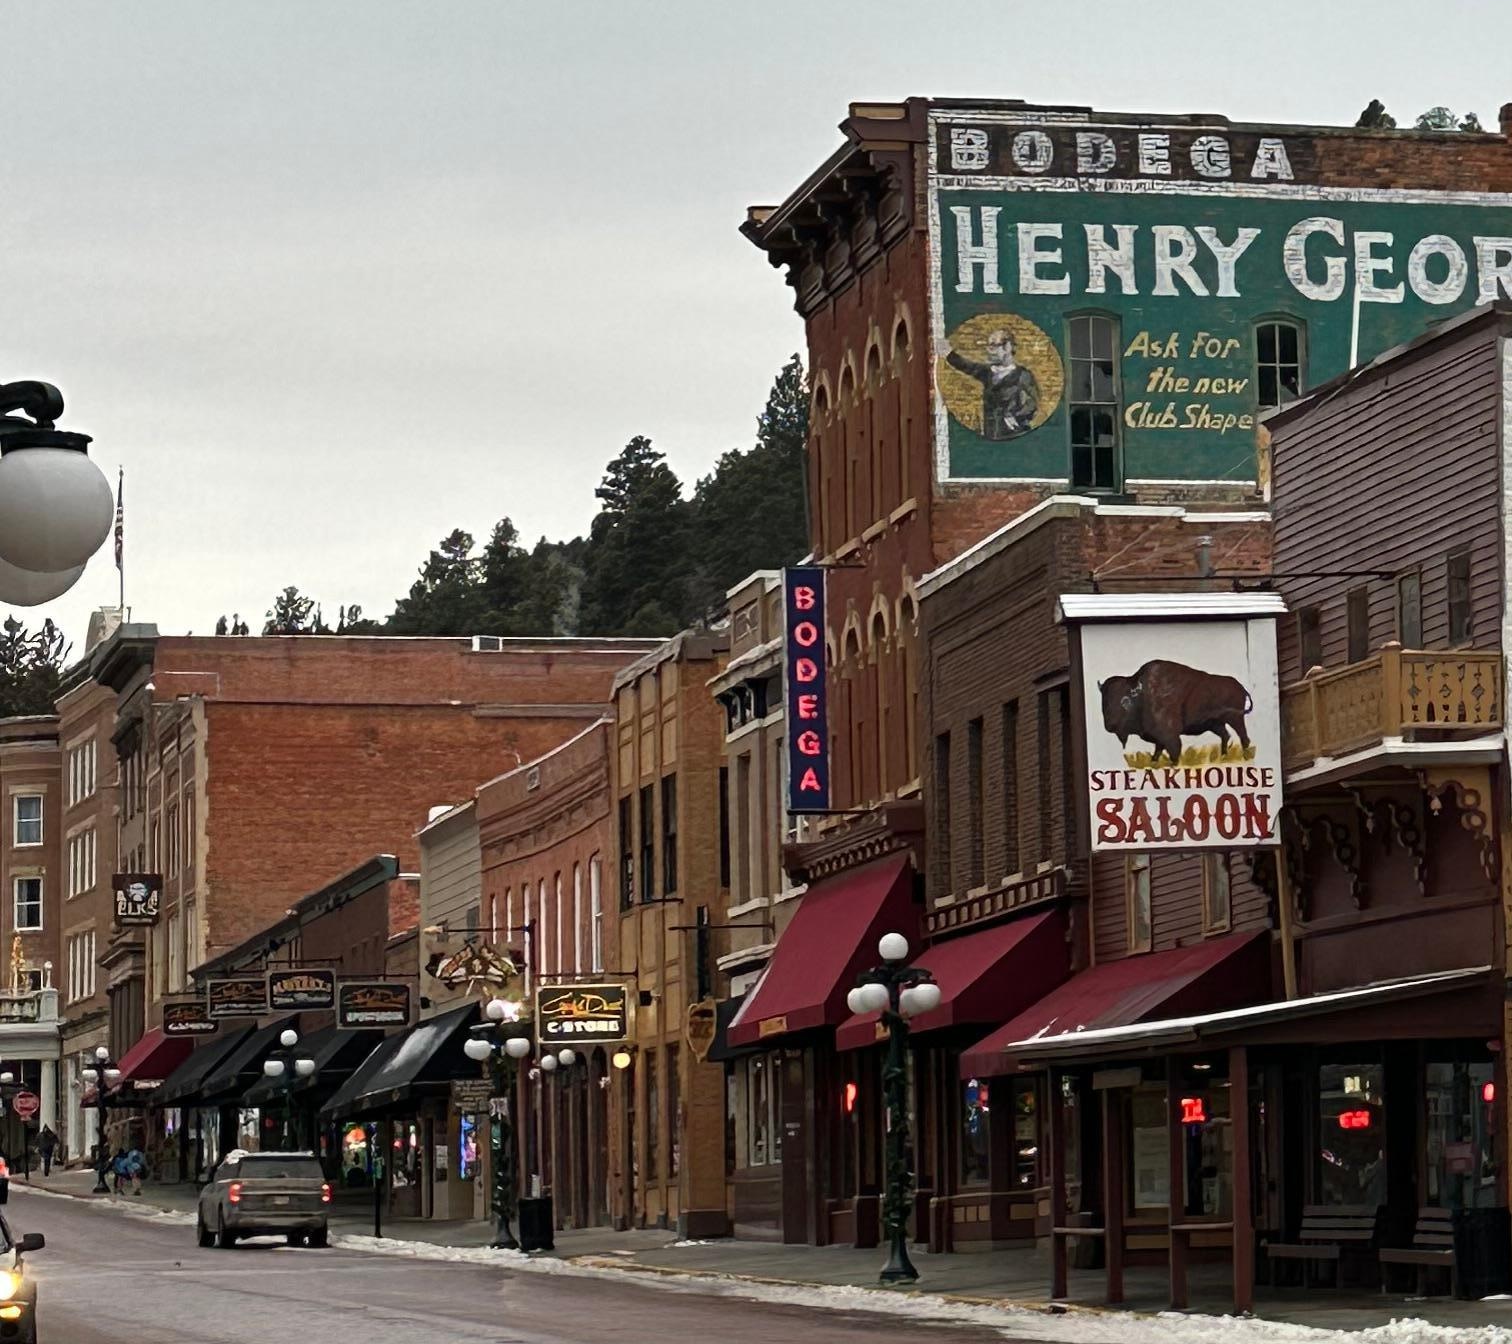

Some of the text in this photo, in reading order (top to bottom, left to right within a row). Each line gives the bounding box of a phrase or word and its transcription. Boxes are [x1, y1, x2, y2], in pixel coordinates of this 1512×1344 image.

[950, 127, 1295, 180] BODEGA
[950, 206, 1262, 297] HENRY
[1124, 331, 1179, 358] Ask
[1146, 367, 1249, 394] the new
[1125, 402, 1254, 435] Club Shape
[794, 586, 821, 792] BODEGA
[1090, 767, 1275, 791] STEAKHOUSE
[1096, 792, 1275, 844] SALOON
